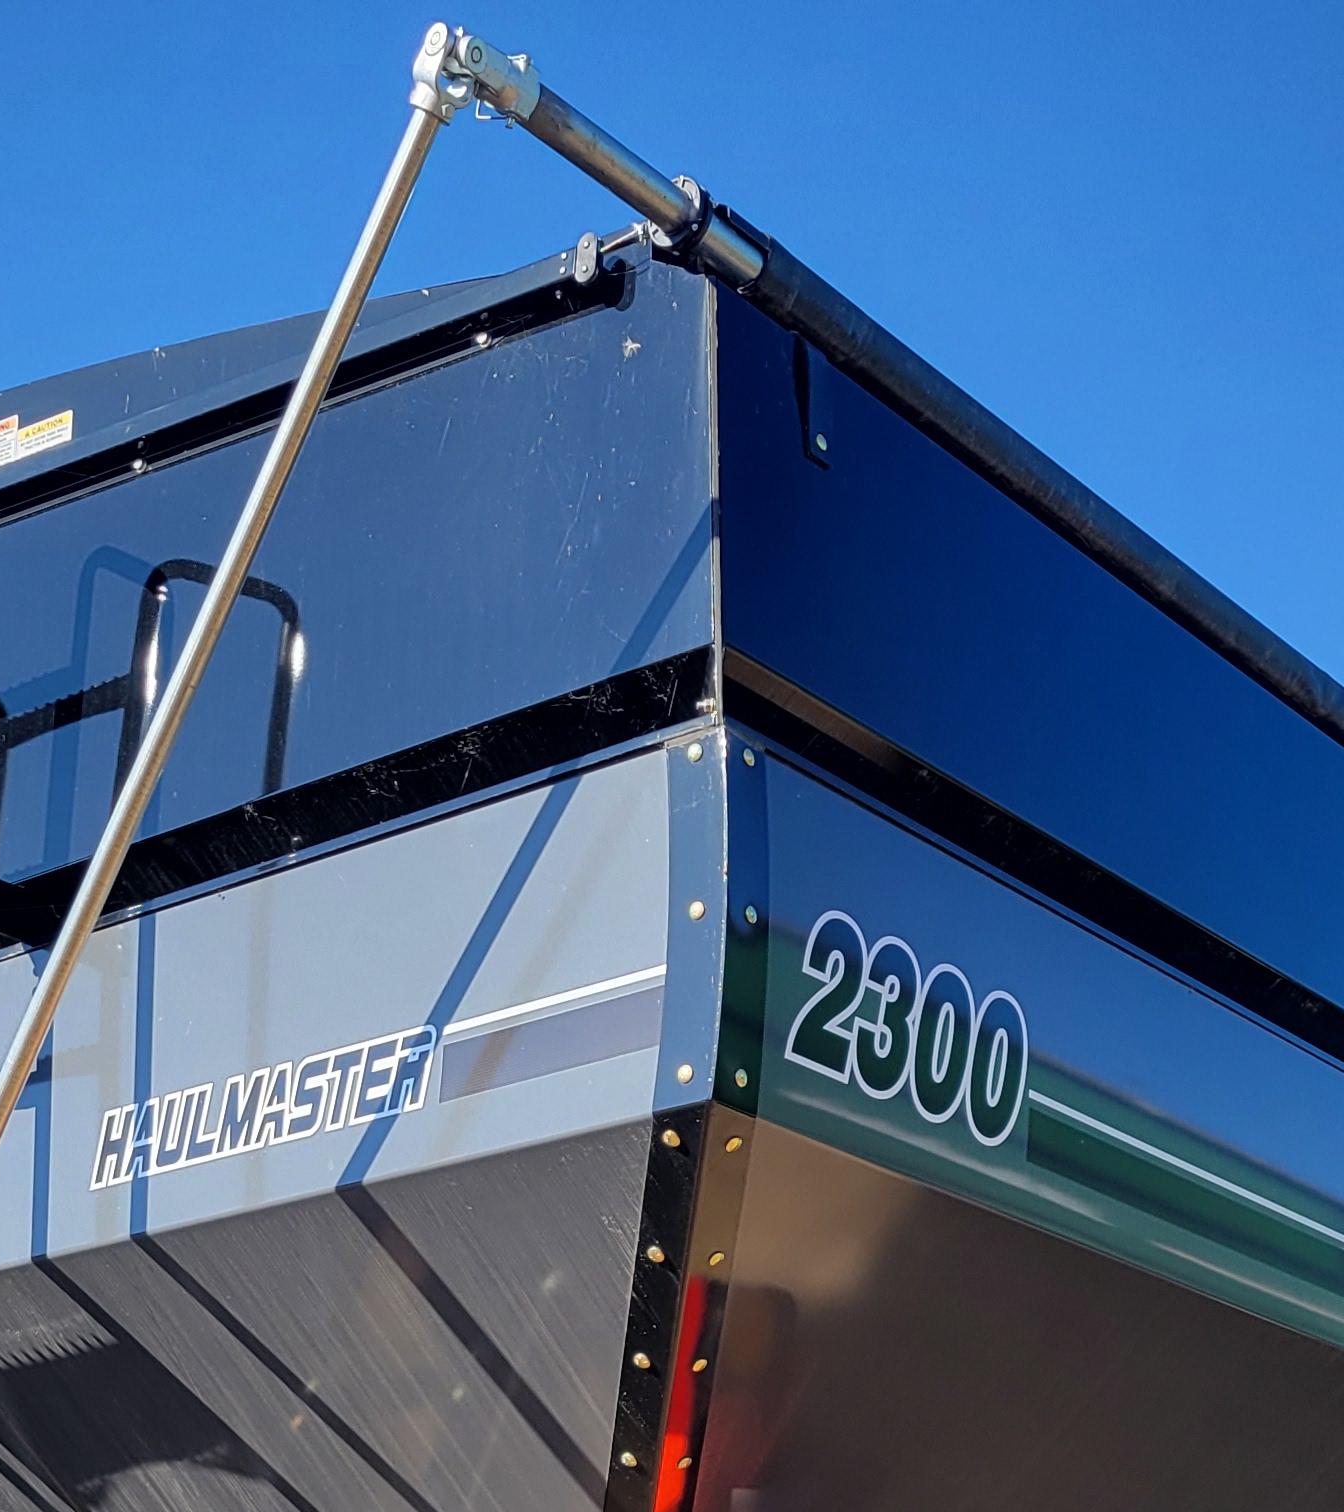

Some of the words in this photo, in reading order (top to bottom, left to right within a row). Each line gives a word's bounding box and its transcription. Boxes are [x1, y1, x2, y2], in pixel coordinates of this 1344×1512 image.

[32, 419, 63, 434] CAUTION
[90, 1024, 438, 1191] HAULMASTER
[784, 910, 1029, 1146] 2300
